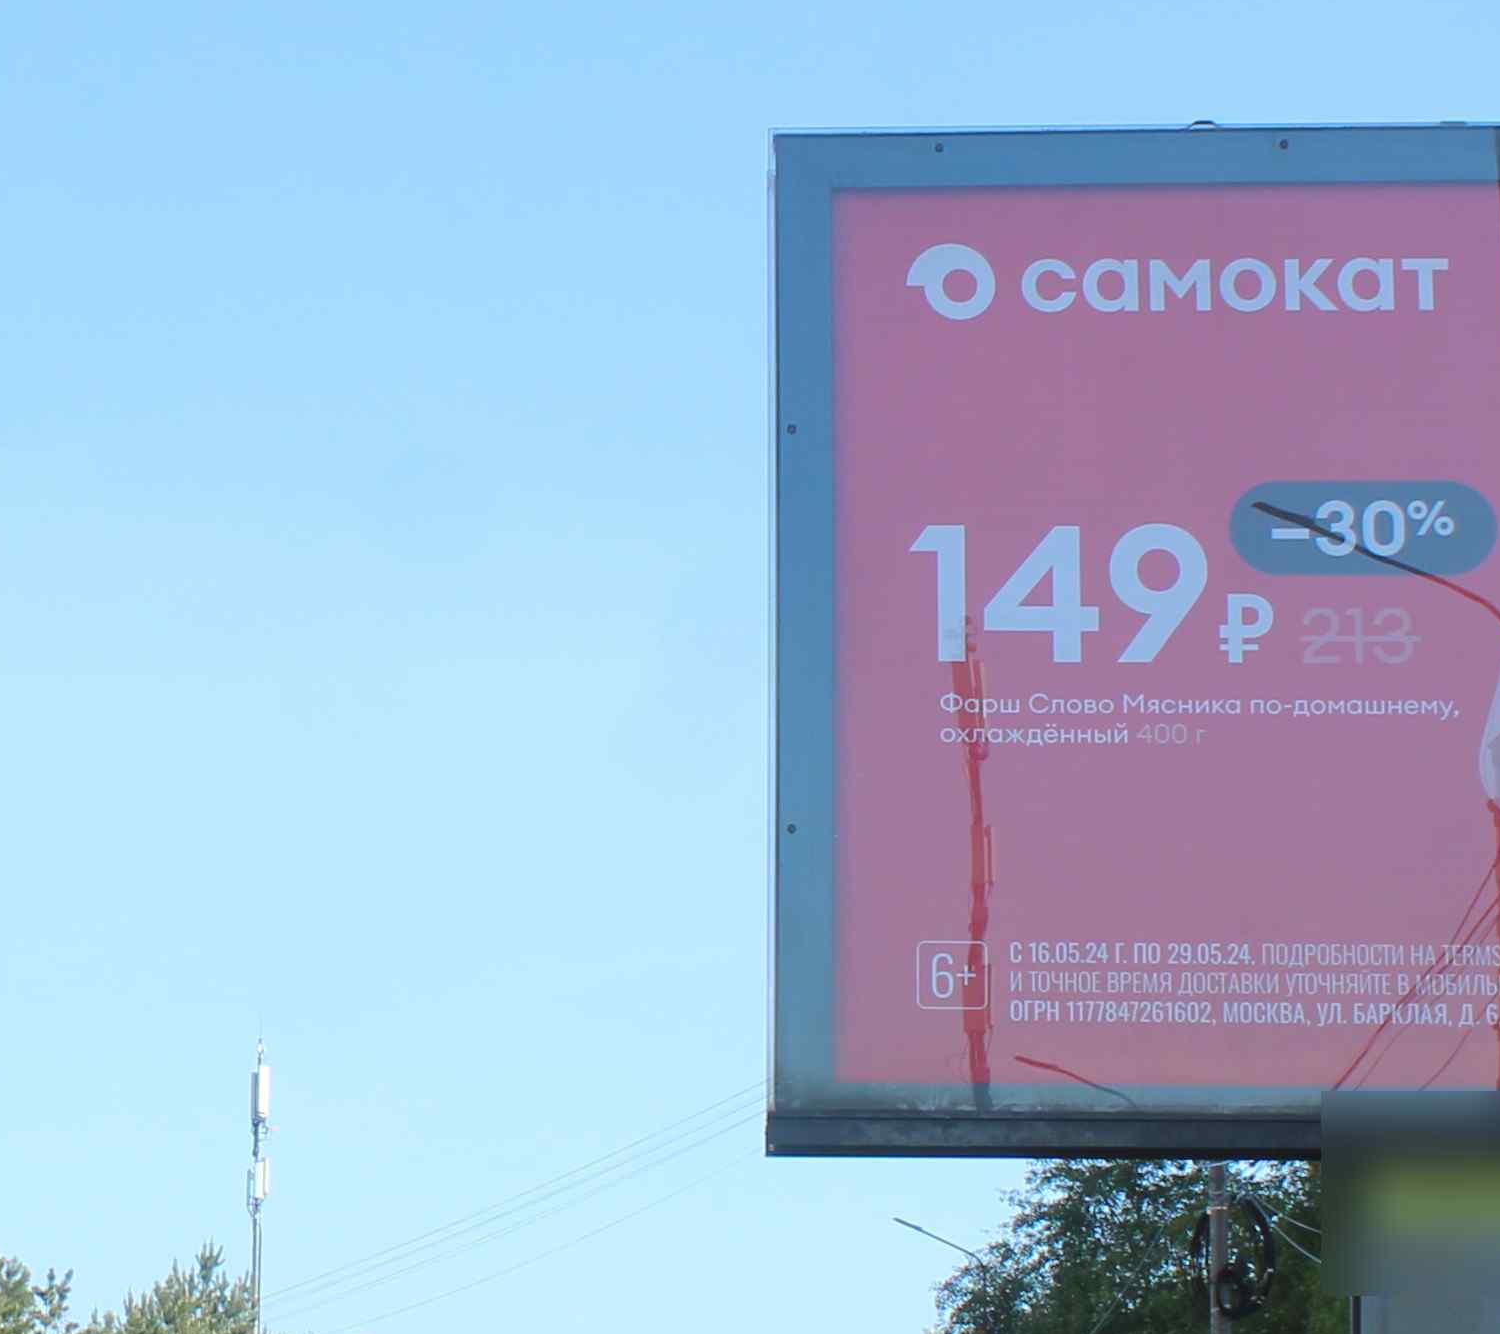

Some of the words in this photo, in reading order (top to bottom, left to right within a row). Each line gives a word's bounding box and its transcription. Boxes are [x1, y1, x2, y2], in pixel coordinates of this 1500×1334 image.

[1021, 257, 1449, 313] самокат
[1301, 607, 1419, 665] 213
[939, 692, 1021, 719] Фарш
[1027, 693, 1115, 715] Слово
[1122, 694, 1241, 715] Мясника
[1249, 698, 1460, 720] по-домашнему,
[939, 723, 1129, 746] охлаждённый
[1136, 723, 1188, 745] 400
[1196, 729, 1207, 745] г
[1009, 942, 1022, 964] С
[1029, 942, 1109, 964] 16.05.24
[1115, 943, 1129, 964] Г.
[1134, 943, 1161, 964] ПО
[1262, 944, 1405, 968] ПОДРОБНОСТИ
[1410, 945, 1436, 966] НА
[930, 953, 977, 999] 6+
[1009, 971, 1023, 994] И
[1028, 971, 1102, 994] ТОЧНОЕ
[1107, 971, 1172, 994] ВРЕМЯ
[1177, 972, 1279, 997] ДОСТАВКИ
[1285, 969, 1393, 996] УТОЧНЯЙТЕ
[1398, 973, 1410, 996] В
[1009, 999, 1060, 1023] ОГРН
[1067, 1000, 1217, 1026] 1177847261602,
[1223, 1001, 1311, 1027] МОСКВА,
[1316, 1002, 1348, 1027] УЛ.
[1352, 1002, 1453, 1028] БАРКЛАЯ,
[1457, 1002, 1481, 1028] Д.
